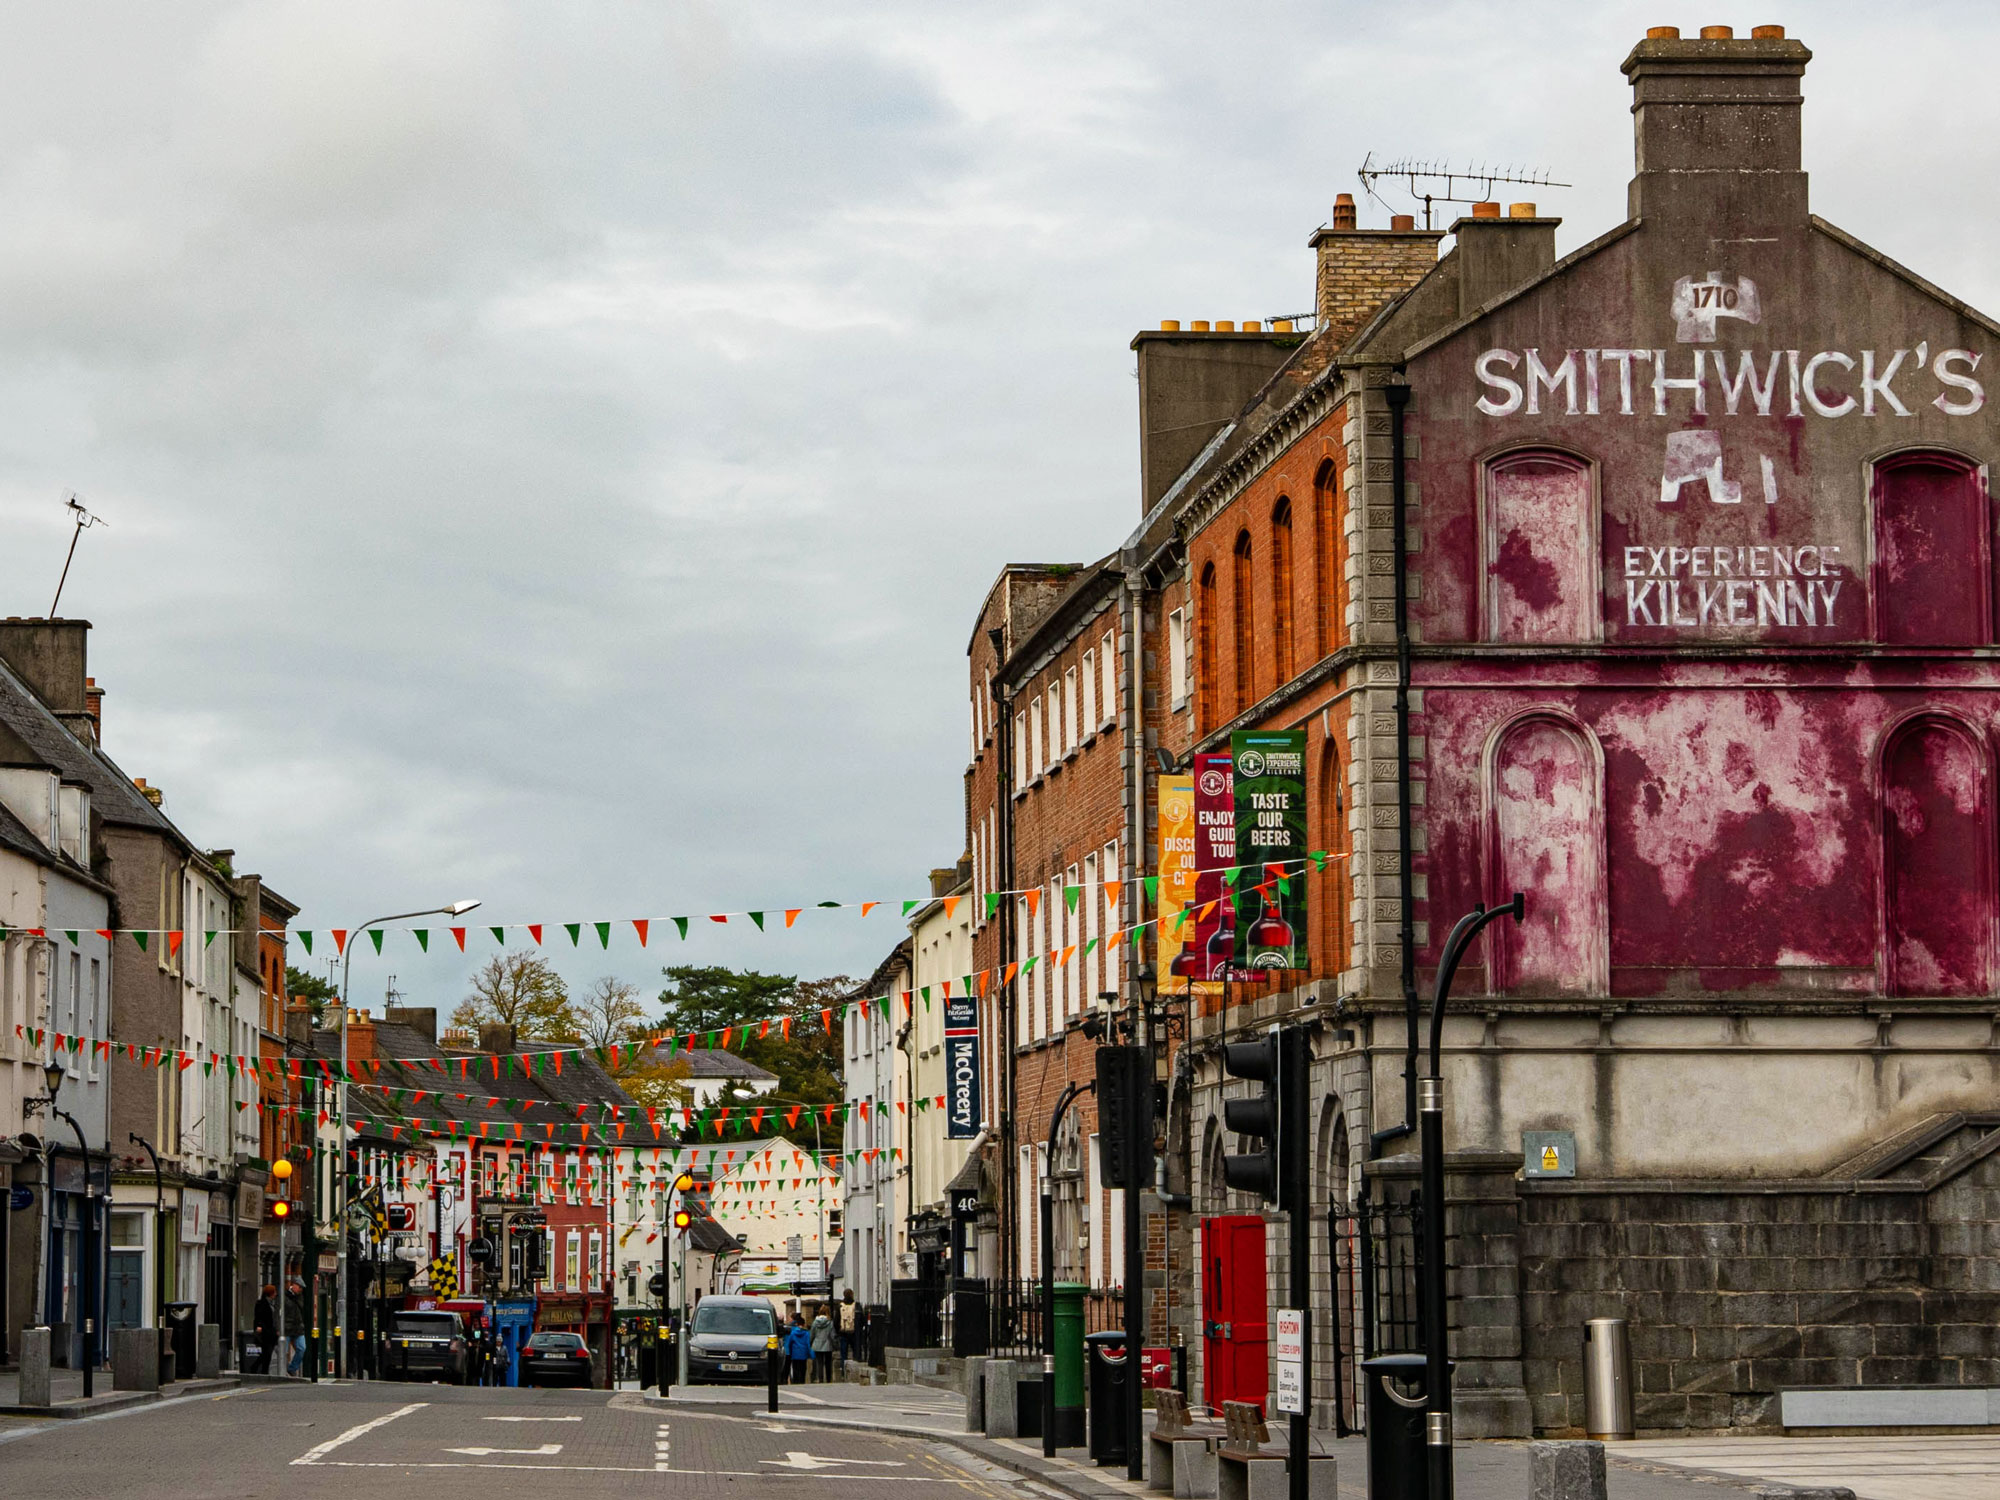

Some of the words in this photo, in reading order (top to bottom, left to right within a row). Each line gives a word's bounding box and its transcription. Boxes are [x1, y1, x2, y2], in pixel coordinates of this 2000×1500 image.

[1692, 286, 1738, 310] 1710
[1474, 340, 1985, 418] SMITHWICK'S
[1624, 546, 1841, 577] EXPERIENCE
[1626, 579, 1842, 628] KILKENNY
[1250, 793, 1290, 809] TASTE
[1199, 811, 1235, 826] ENJOY
[1257, 811, 1284, 828] OUR
[1209, 827, 1235, 842] GUID
[1251, 829, 1291, 846] BEERS
[1211, 843, 1236, 858] TOU
[1180, 854, 1196, 869] OU
[952, 1042, 974, 1128] McCreery
[958, 1197, 977, 1212] 40
